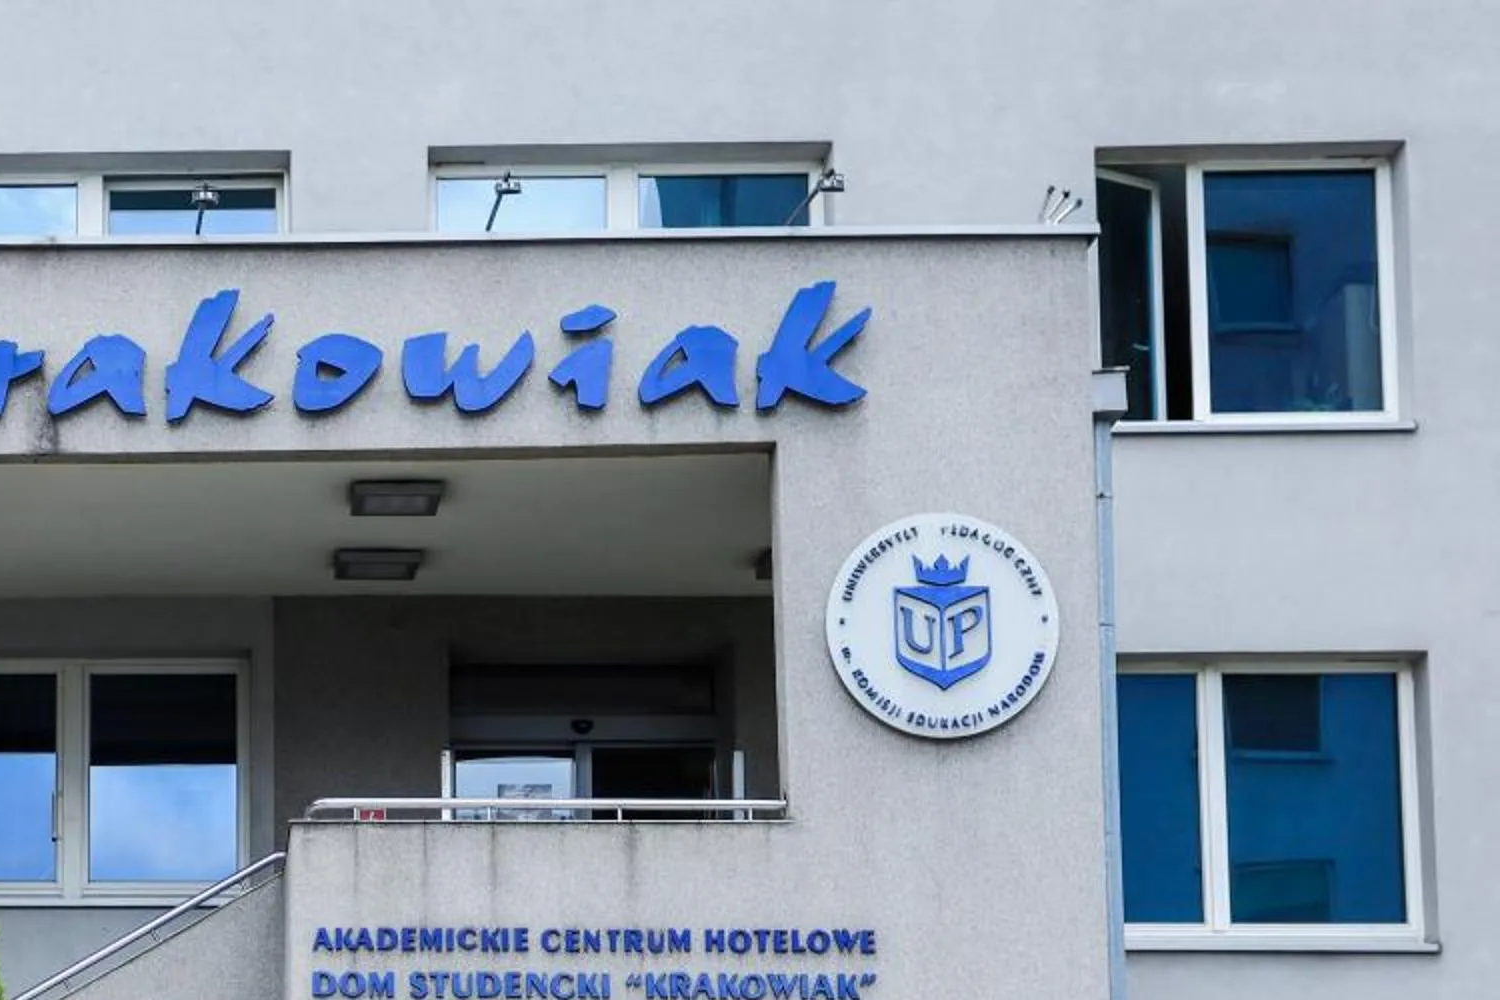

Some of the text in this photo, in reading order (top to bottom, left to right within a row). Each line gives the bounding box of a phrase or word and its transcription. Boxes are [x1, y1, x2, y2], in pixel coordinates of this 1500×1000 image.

[940, 523, 1043, 597] PEDAGOGCZNY
[899, 604, 984, 660] UP
[906, 711, 985, 731] EDUKACJI
[311, 927, 877, 955] AKADEMICKIE CENTRUM HOTELOWE
[311, 970, 397, 999] DOM
[409, 971, 613, 1000] STUDENCKI
